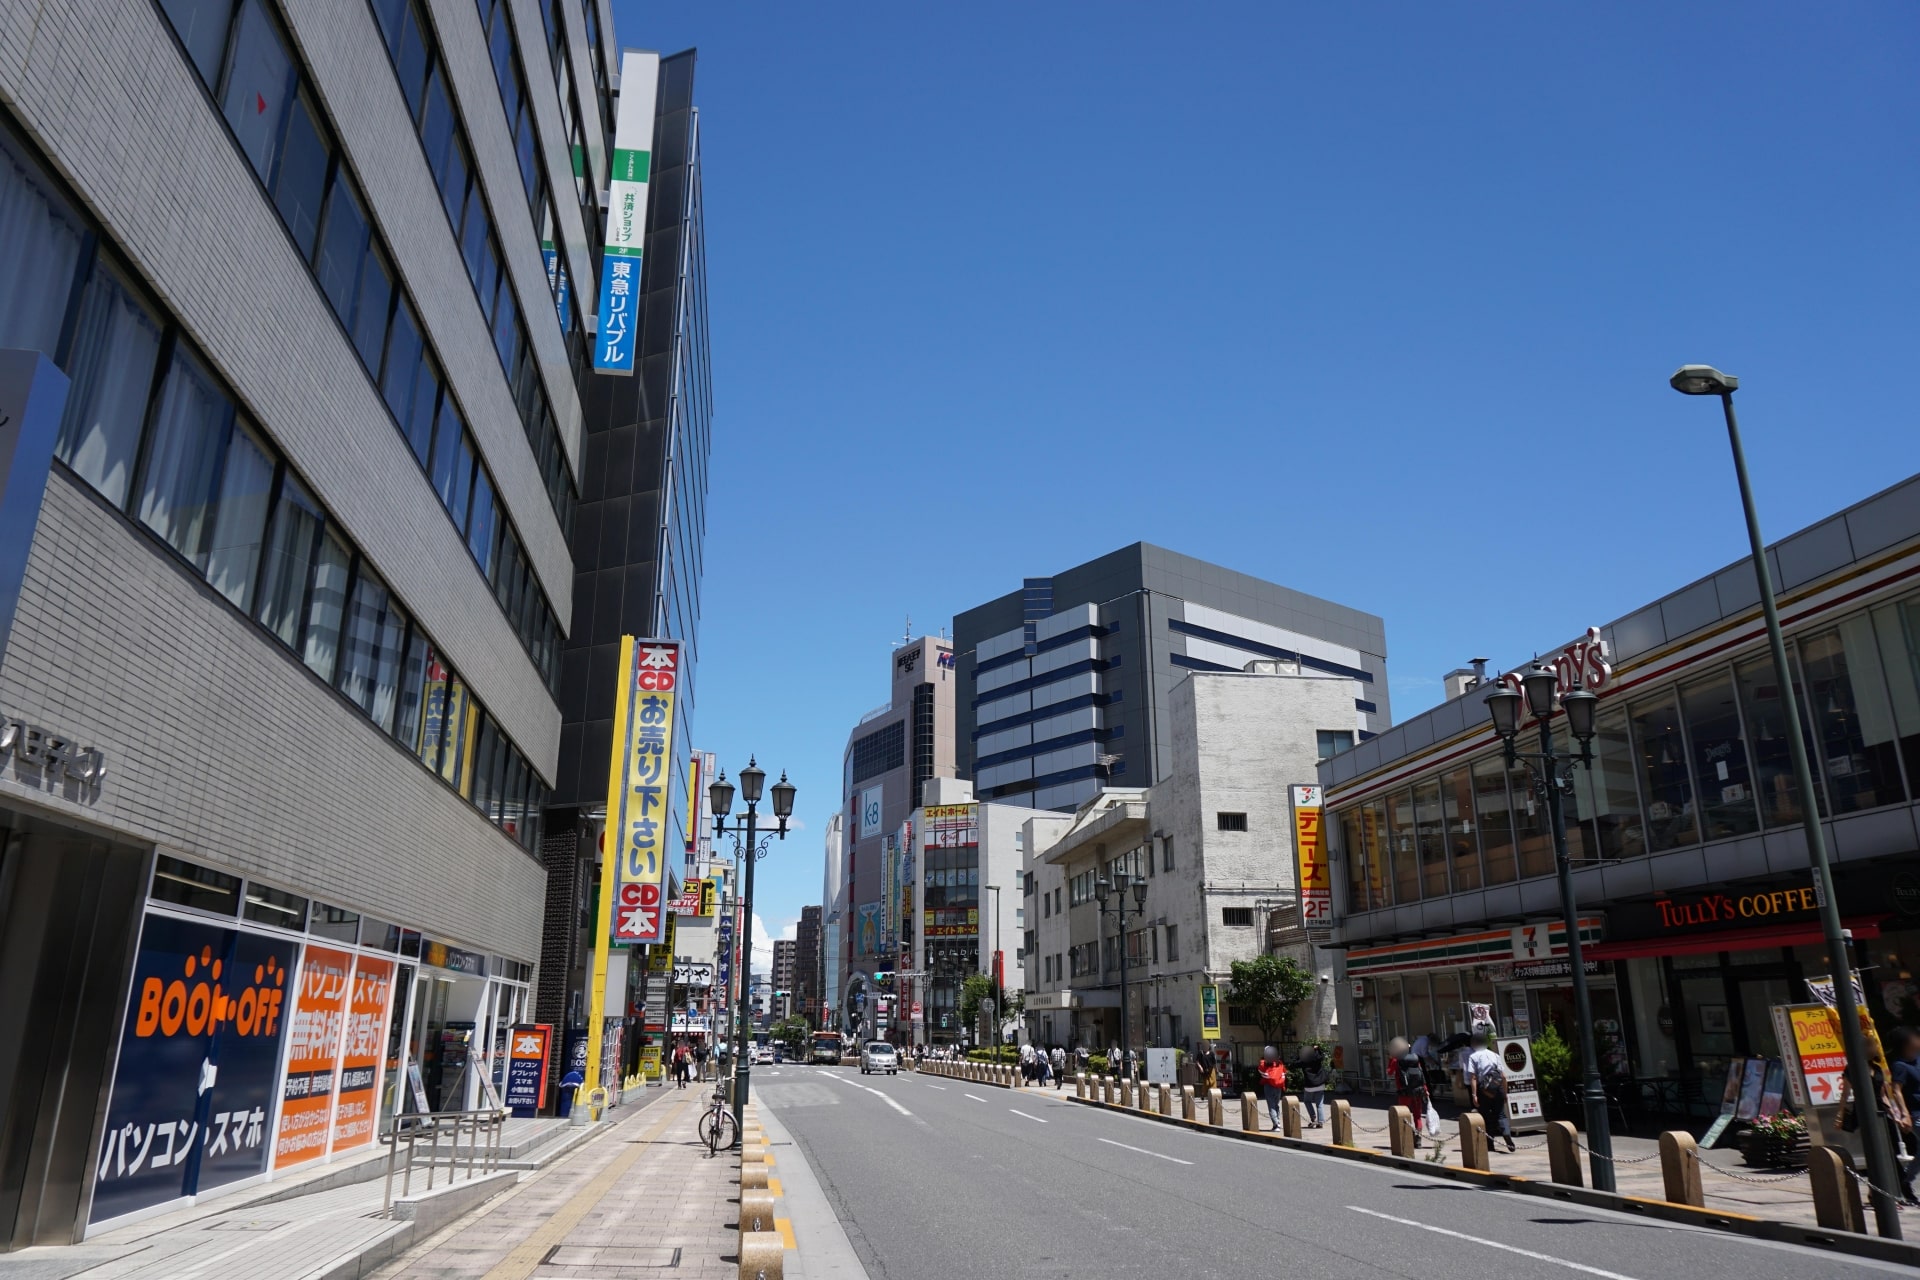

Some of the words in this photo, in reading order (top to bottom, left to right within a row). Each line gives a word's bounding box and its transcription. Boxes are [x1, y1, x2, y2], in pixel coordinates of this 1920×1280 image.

[622, 192, 634, 241] 共済ショップ
[603, 261, 631, 363] 東急リバブル
[640, 645, 675, 670] 本
[638, 670, 675, 691] CD
[628, 695, 669, 877] お売り下さい
[926, 806, 969, 818] エイトホーム
[1299, 811, 1327, 881] デニーズ
[621, 884, 659, 905] CD
[1739, 887, 1820, 918] COFFE
[1304, 901, 1330, 918] 2F
[619, 908, 656, 936] 本
[515, 1035, 541, 1055] 本
[571, 1059, 587, 1067] BOS
[286, 1077, 310, 1097] 予約不要
